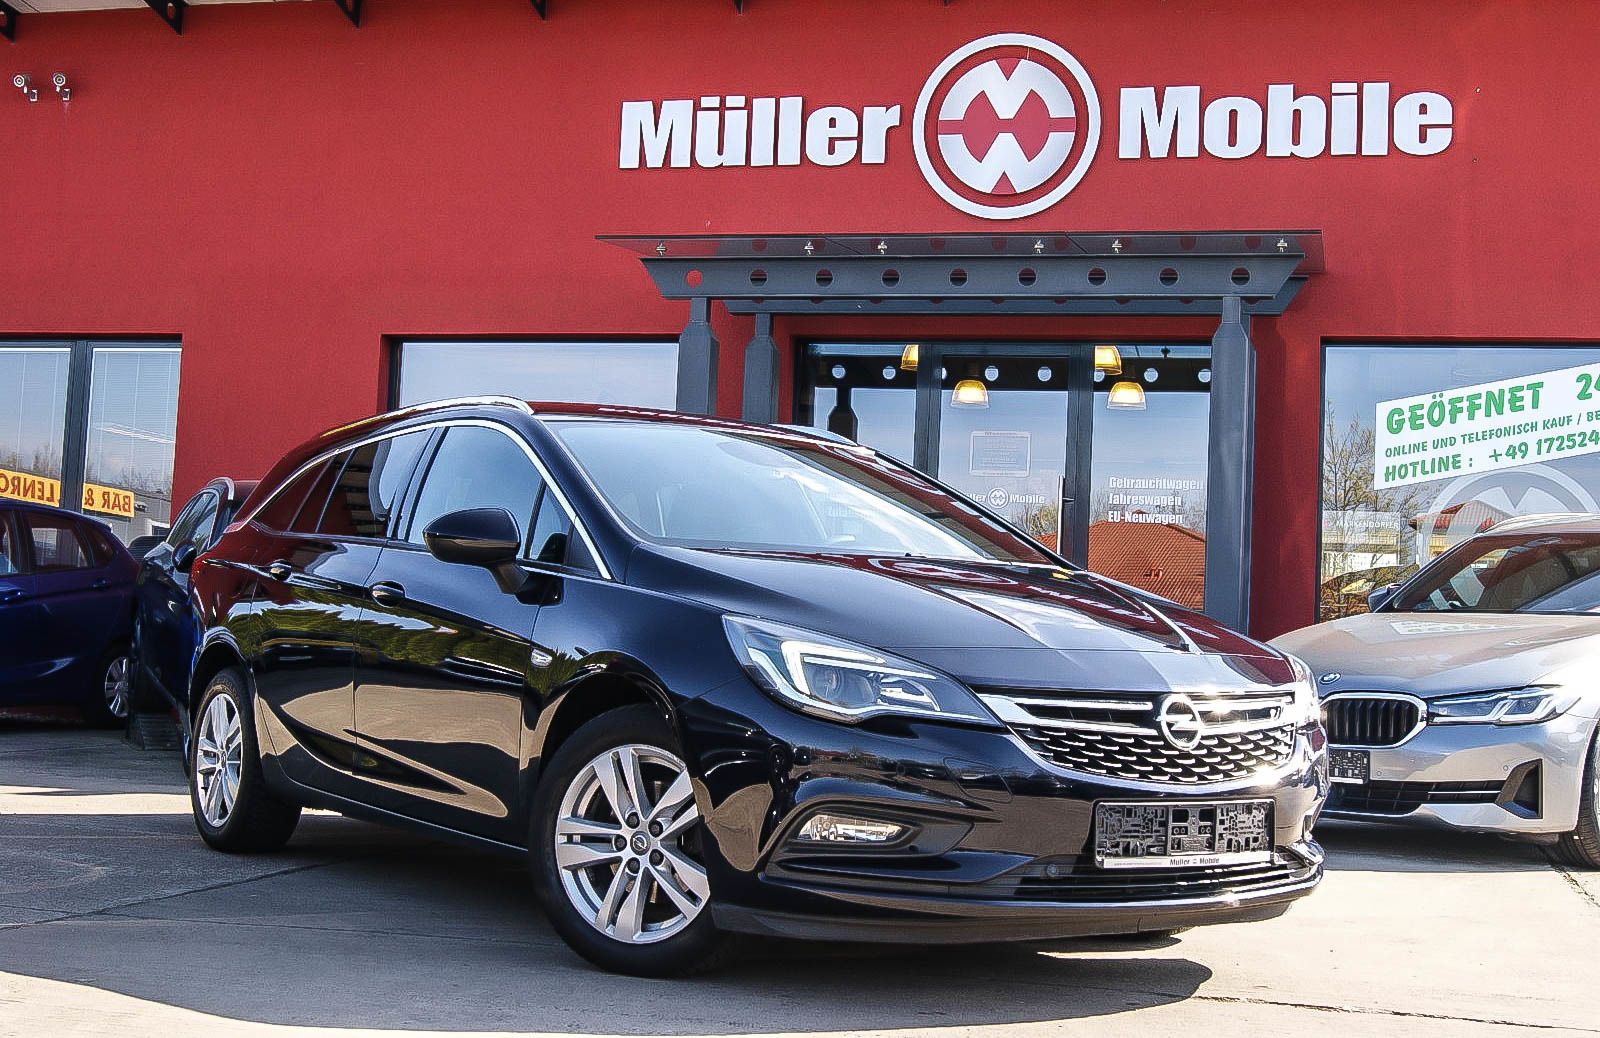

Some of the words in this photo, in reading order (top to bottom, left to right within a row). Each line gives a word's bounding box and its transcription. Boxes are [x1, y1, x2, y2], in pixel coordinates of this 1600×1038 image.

[619, 94, 902, 170] Müller
[1118, 81, 1455, 161] Mobile
[1386, 381, 1544, 434] GEÖFFNET
[1385, 441, 1428, 458] ONLINE
[1432, 436, 1457, 450] UND
[1461, 422, 1538, 445] TELEFONISCH
[1543, 414, 1573, 430] KAUF
[1489, 441, 1529, 463] +49
[1536, 429, 1600, 456] 172524
[1009, 493, 1045, 503] Mobile
[1108, 493, 1182, 507] Jahreswagen
[1107, 510, 1184, 525] EU-Neuwagen
